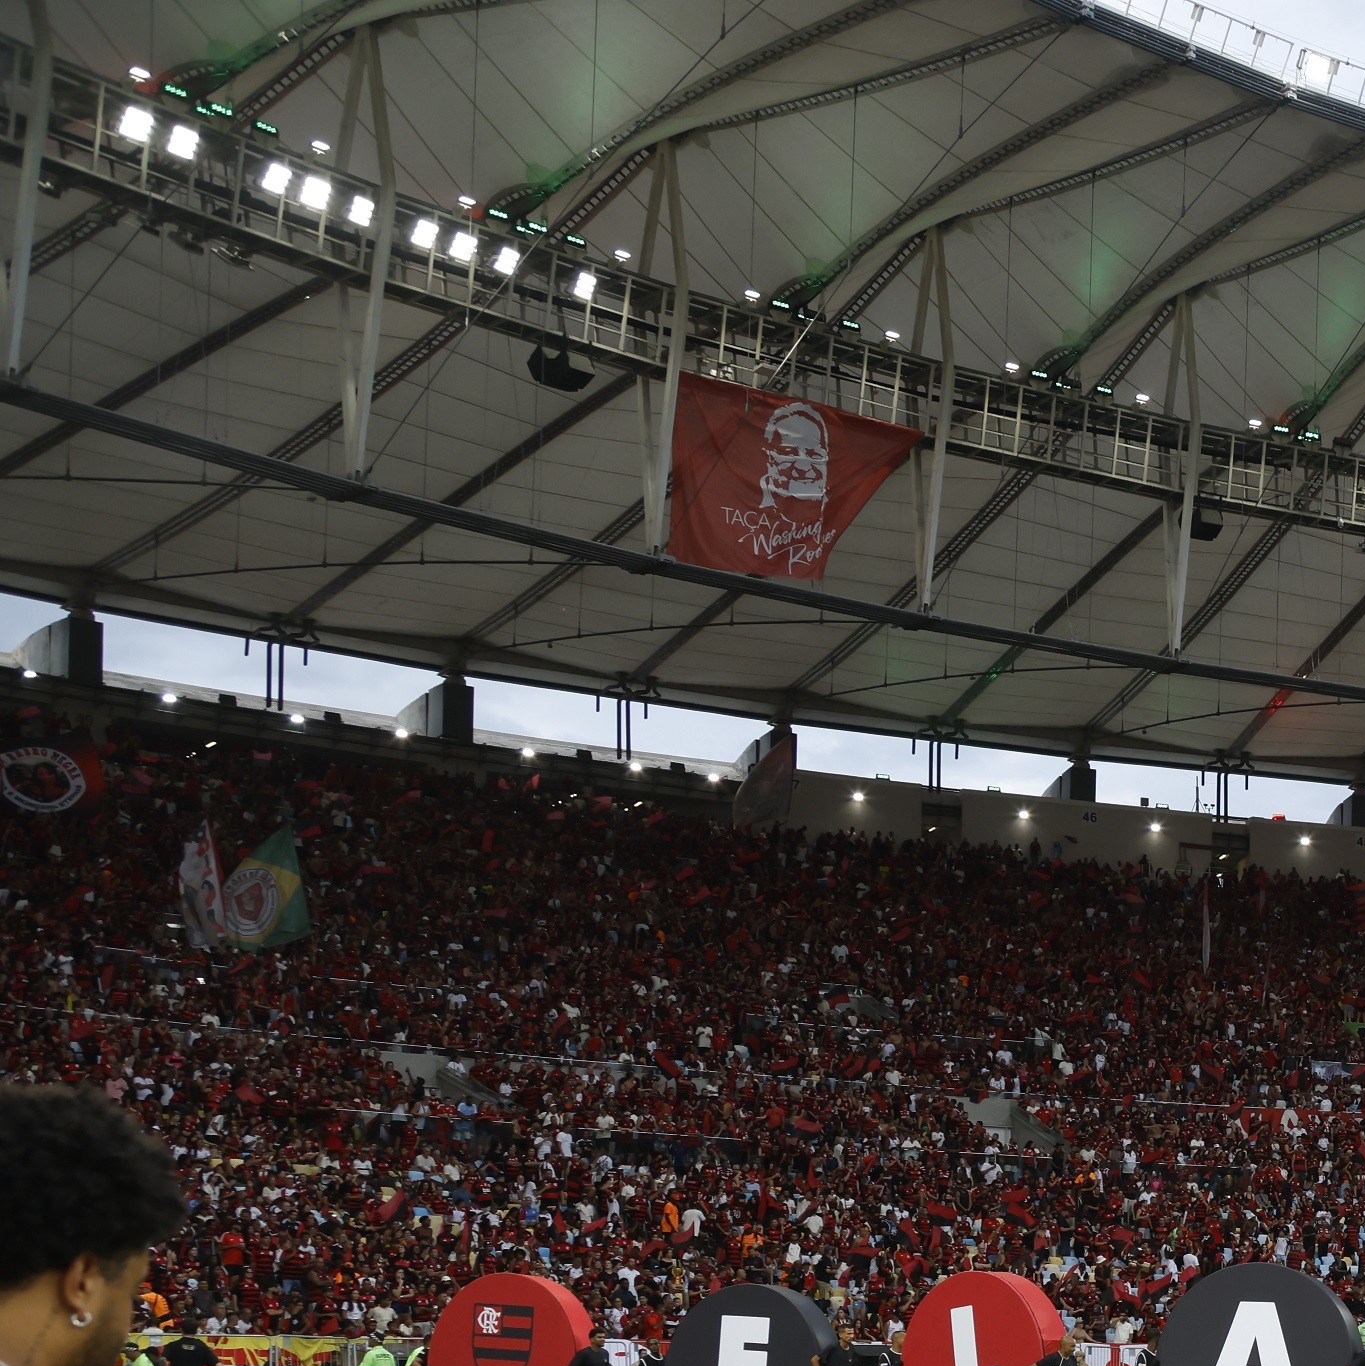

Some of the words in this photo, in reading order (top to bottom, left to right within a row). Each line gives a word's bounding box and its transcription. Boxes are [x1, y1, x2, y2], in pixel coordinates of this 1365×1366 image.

[721, 506, 772, 533] TAÇA
[738, 518, 823, 556] Washing
[1082, 812, 1098, 824] 46
